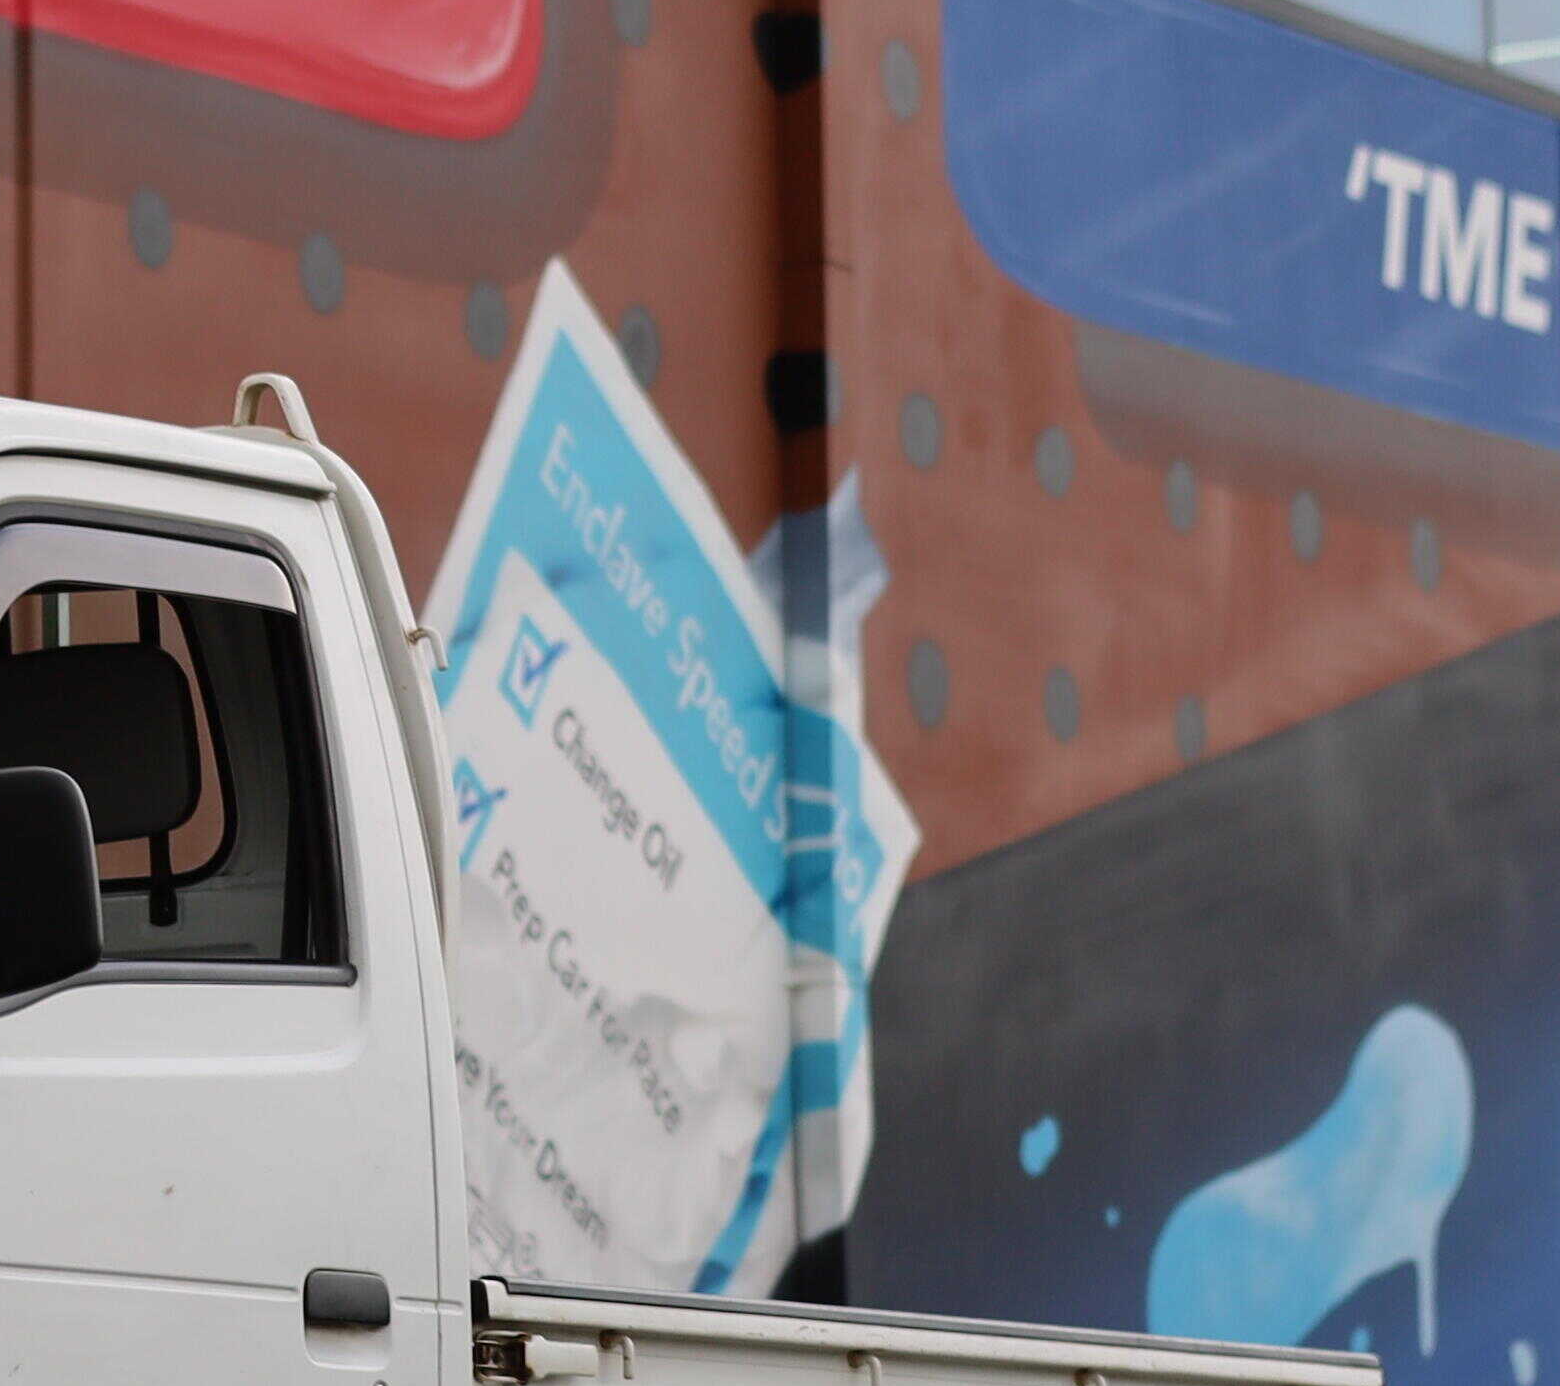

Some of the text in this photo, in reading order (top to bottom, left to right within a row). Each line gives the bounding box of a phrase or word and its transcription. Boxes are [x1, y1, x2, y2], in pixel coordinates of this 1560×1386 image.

[539, 421, 671, 637] Enclave
[666, 616, 778, 810] Speed
[553, 707, 684, 891] Change Oil
[491, 848, 543, 945] Prep
[548, 928, 589, 998] Car
[630, 1038, 680, 1134] Race
[486, 1066, 537, 1150] Your
[537, 1139, 609, 1250] Dream
